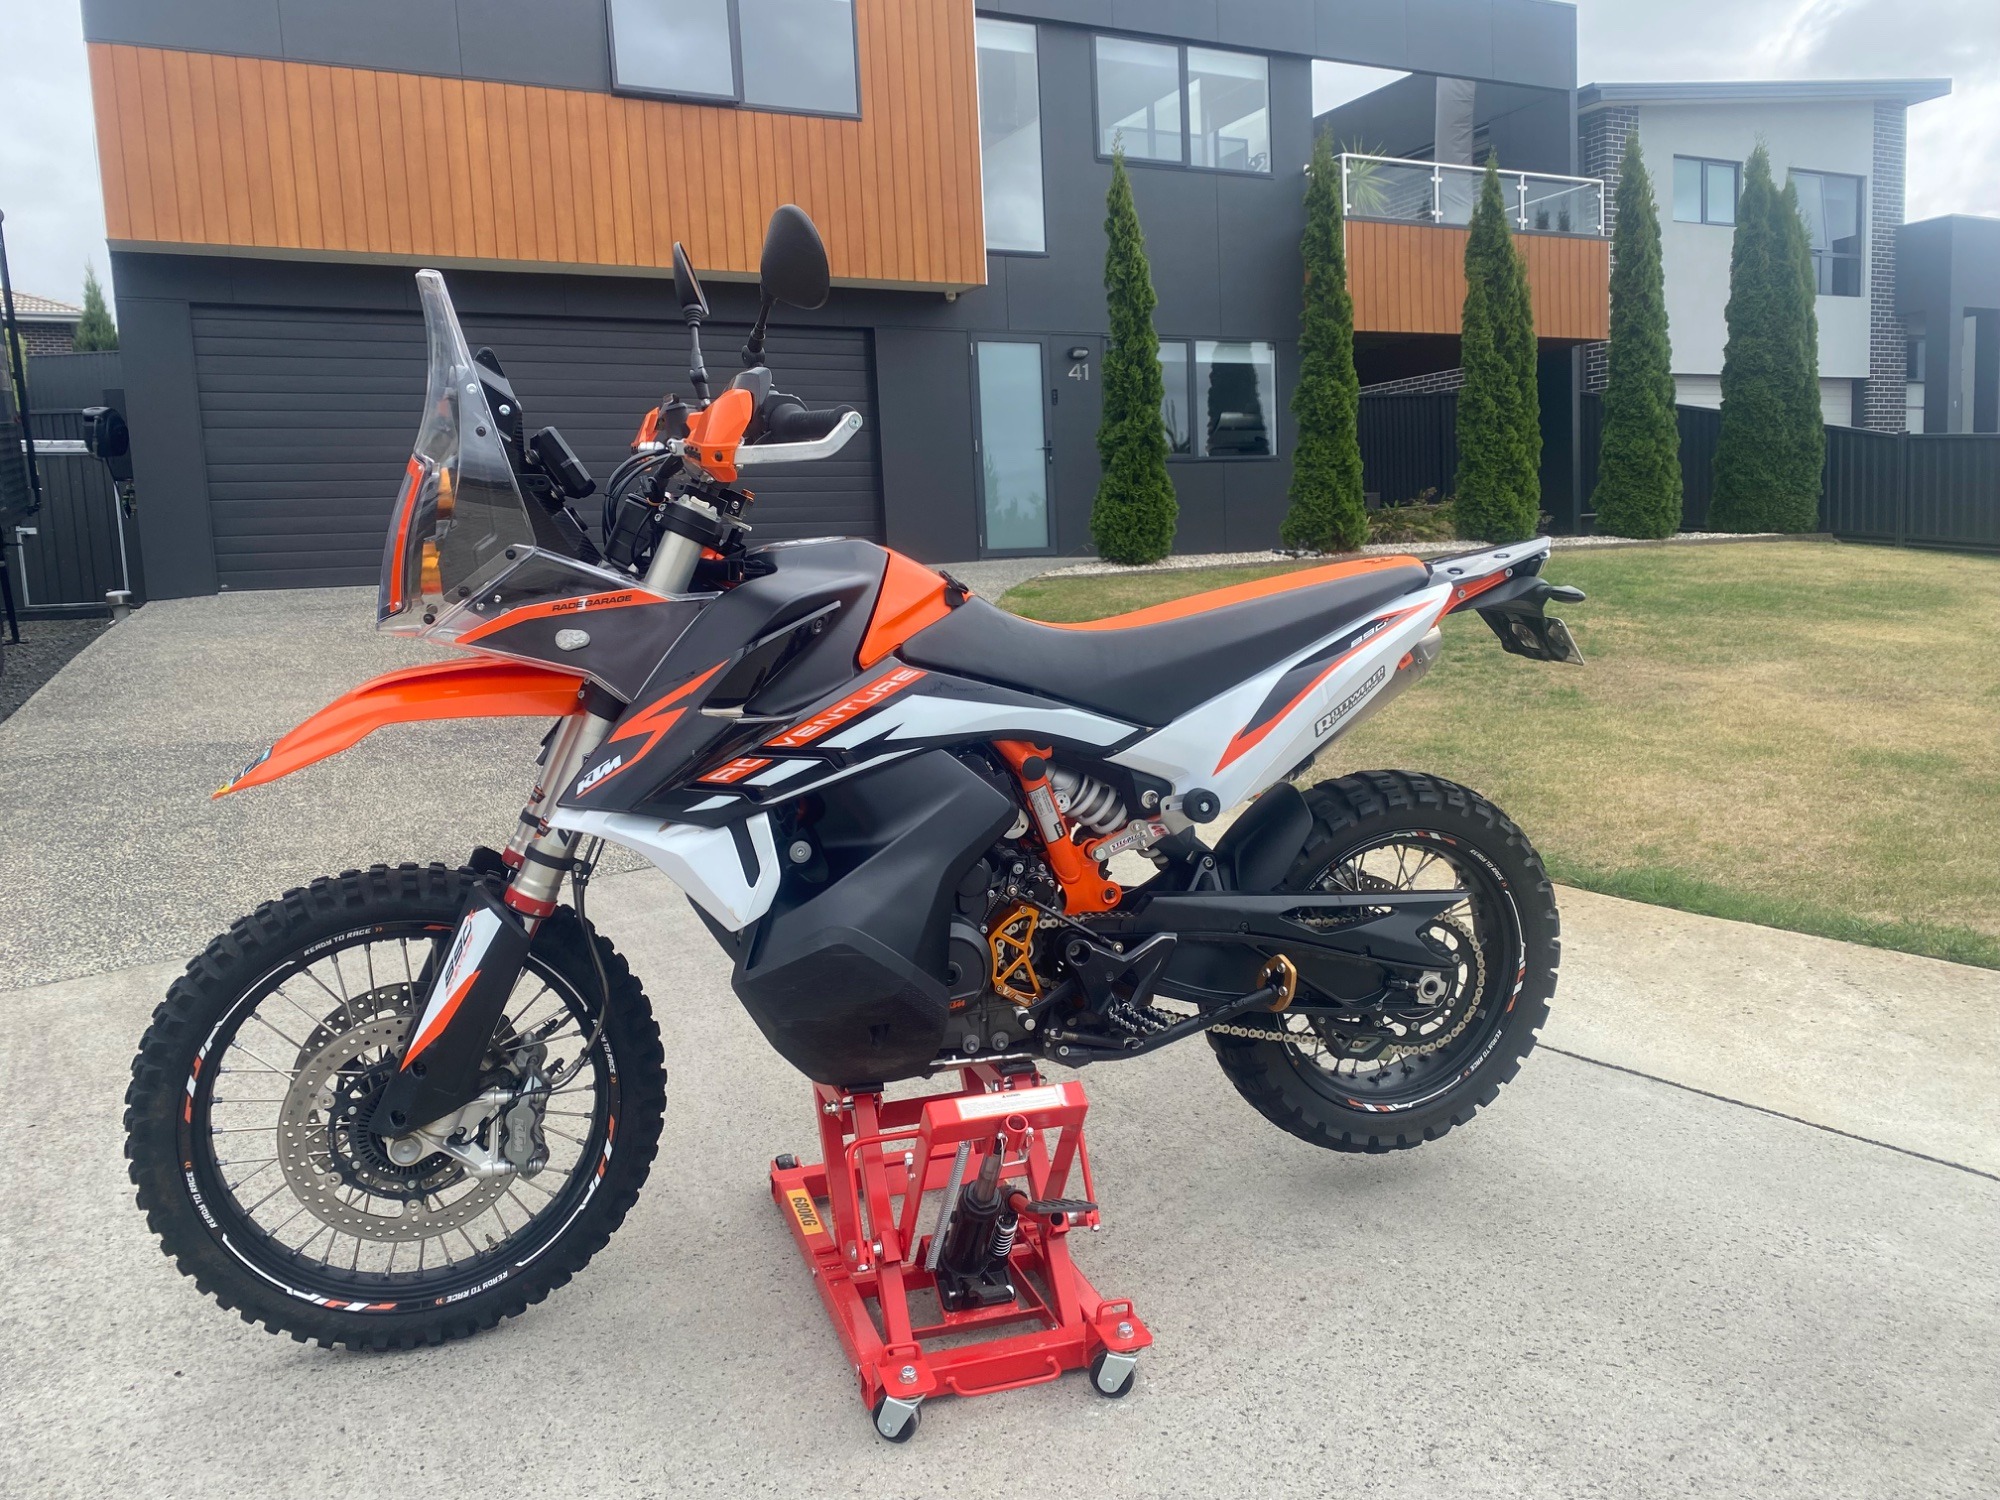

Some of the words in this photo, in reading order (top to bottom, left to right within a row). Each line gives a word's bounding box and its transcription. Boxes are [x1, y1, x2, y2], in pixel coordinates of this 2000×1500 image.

[1068, 363, 1089, 380] 41
[585, 595, 632, 606] GARAGE
[576, 754, 622, 796] KTM
[303, 939, 332, 956] READY
[333, 934, 345, 943] TO
[346, 927, 371, 939] RACE
[513, 1117, 527, 1152] KTM
[186, 1171, 198, 1193] RACE
[192, 1193, 203, 1205] TO
[198, 1203, 218, 1229] READY
[792, 1196, 818, 1226] 680KG
[470, 1284, 482, 1295] TO
[482, 1270, 508, 1290] READY
[446, 1289, 469, 1303] RACE
